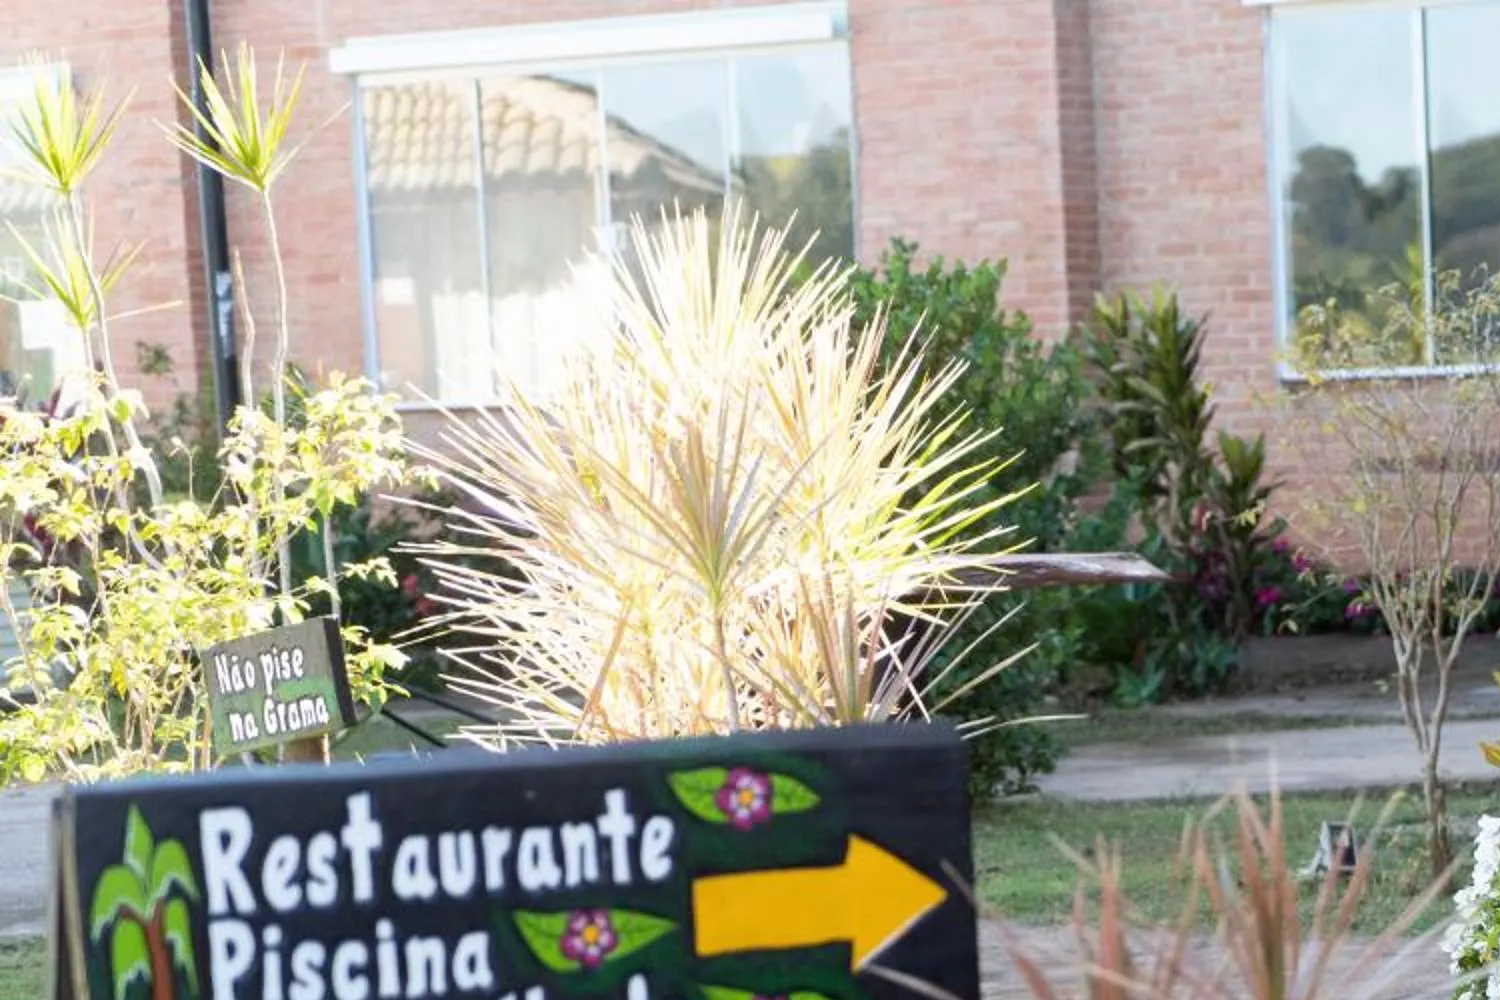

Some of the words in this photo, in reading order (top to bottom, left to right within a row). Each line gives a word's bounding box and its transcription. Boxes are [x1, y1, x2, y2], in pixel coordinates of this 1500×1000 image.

[215, 654, 256, 694] Não
[260, 648, 304, 696] pise
[230, 712, 259, 742] na
[264, 696, 329, 734] Grama
[200, 788, 674, 915] Restaurante
